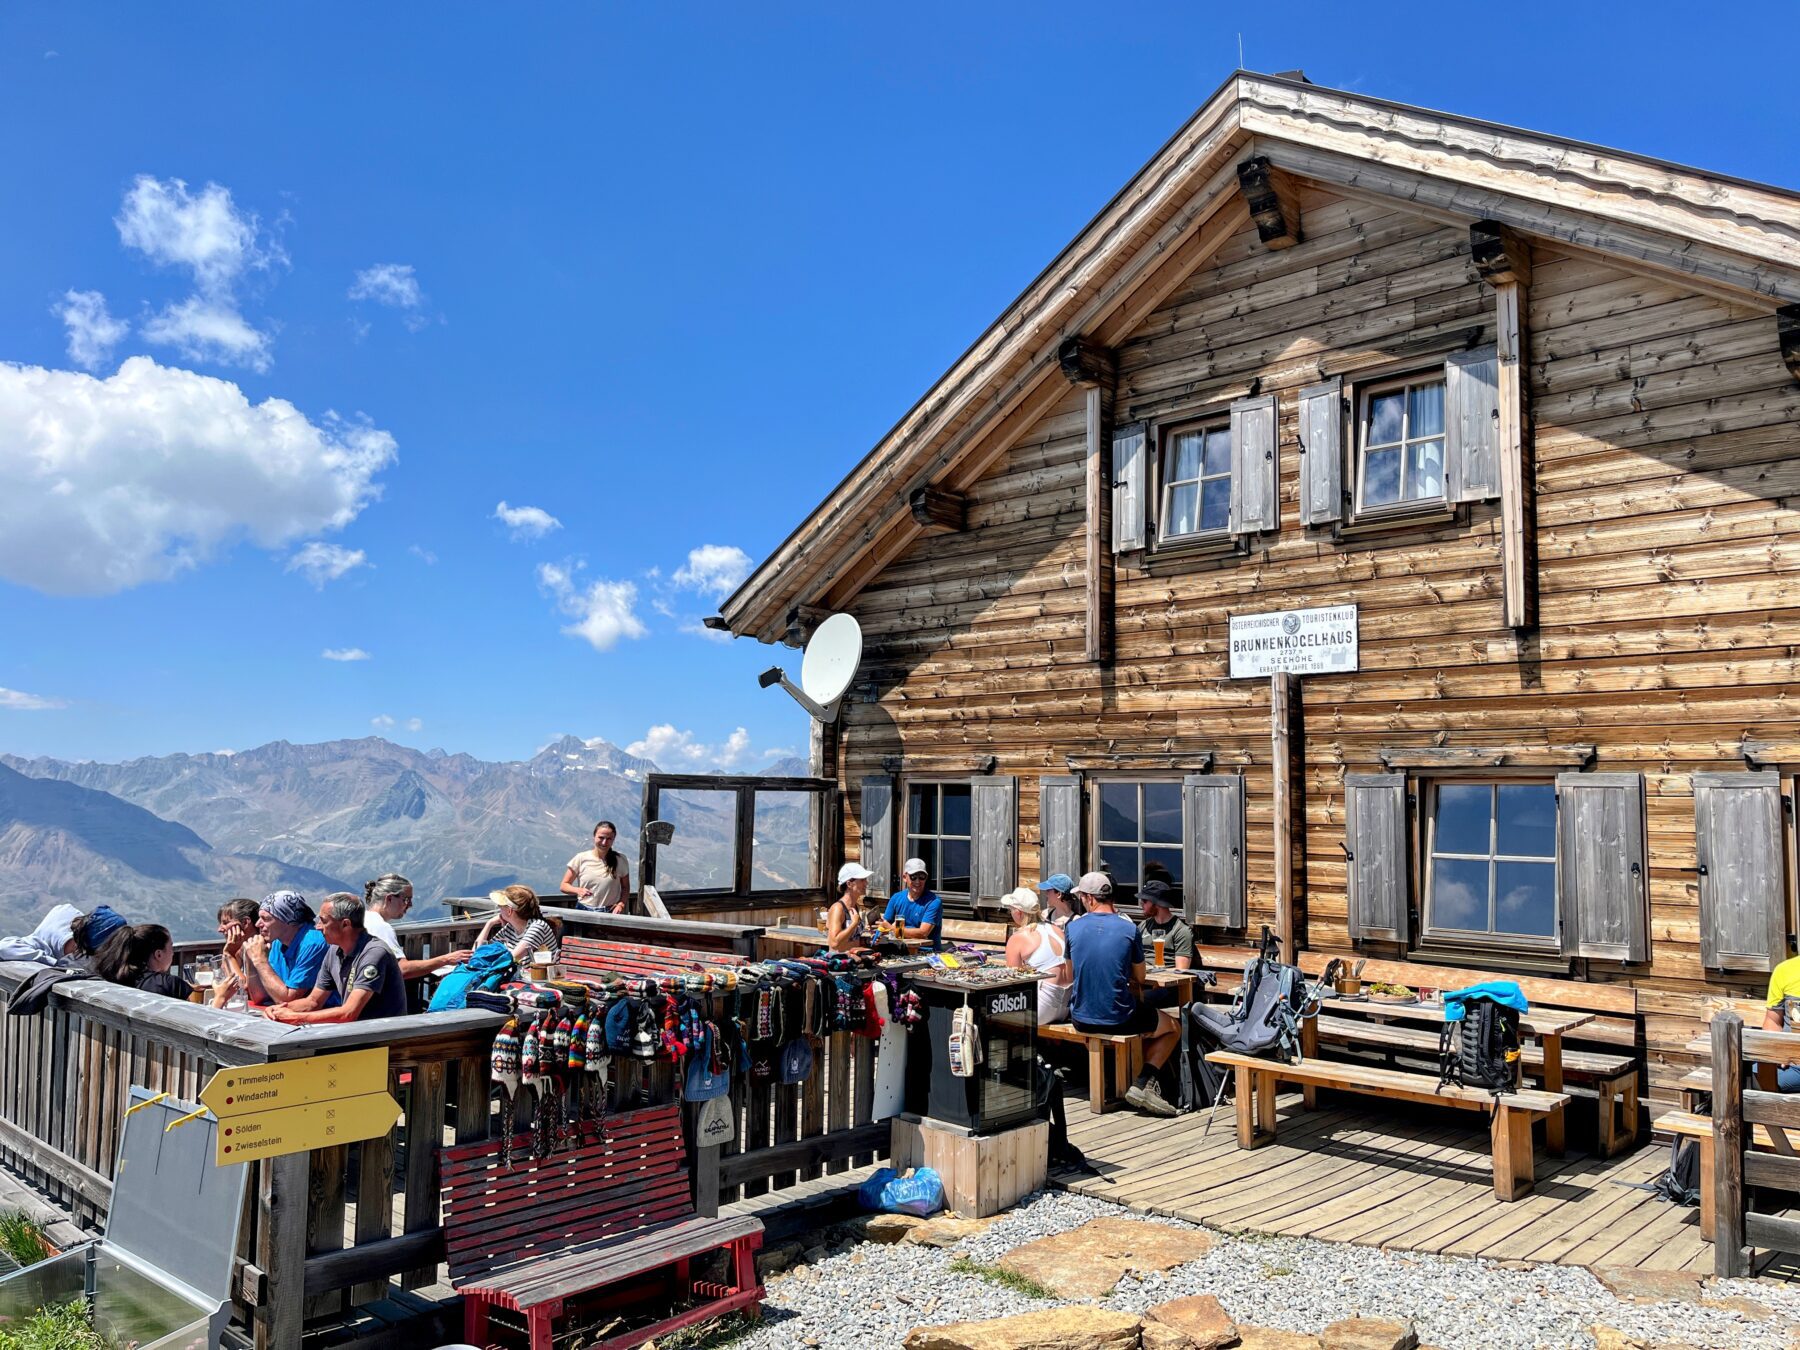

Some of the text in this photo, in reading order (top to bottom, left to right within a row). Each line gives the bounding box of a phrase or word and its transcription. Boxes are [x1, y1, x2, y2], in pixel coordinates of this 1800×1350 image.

[1302, 610, 1354, 624] TOURISTENKLUB
[1233, 630, 1353, 653] BRUNNENKOGELHAUS
[1259, 665, 1280, 673] ERBAUT
[1292, 663, 1308, 671] JAHRE
[991, 991, 1027, 1014] sölsch
[238, 1072, 285, 1086] Timmelsjoch
[236, 1089, 278, 1103] Windachtal
[235, 1123, 262, 1135] Sölden
[235, 1136, 282, 1151] Zwieselstein
